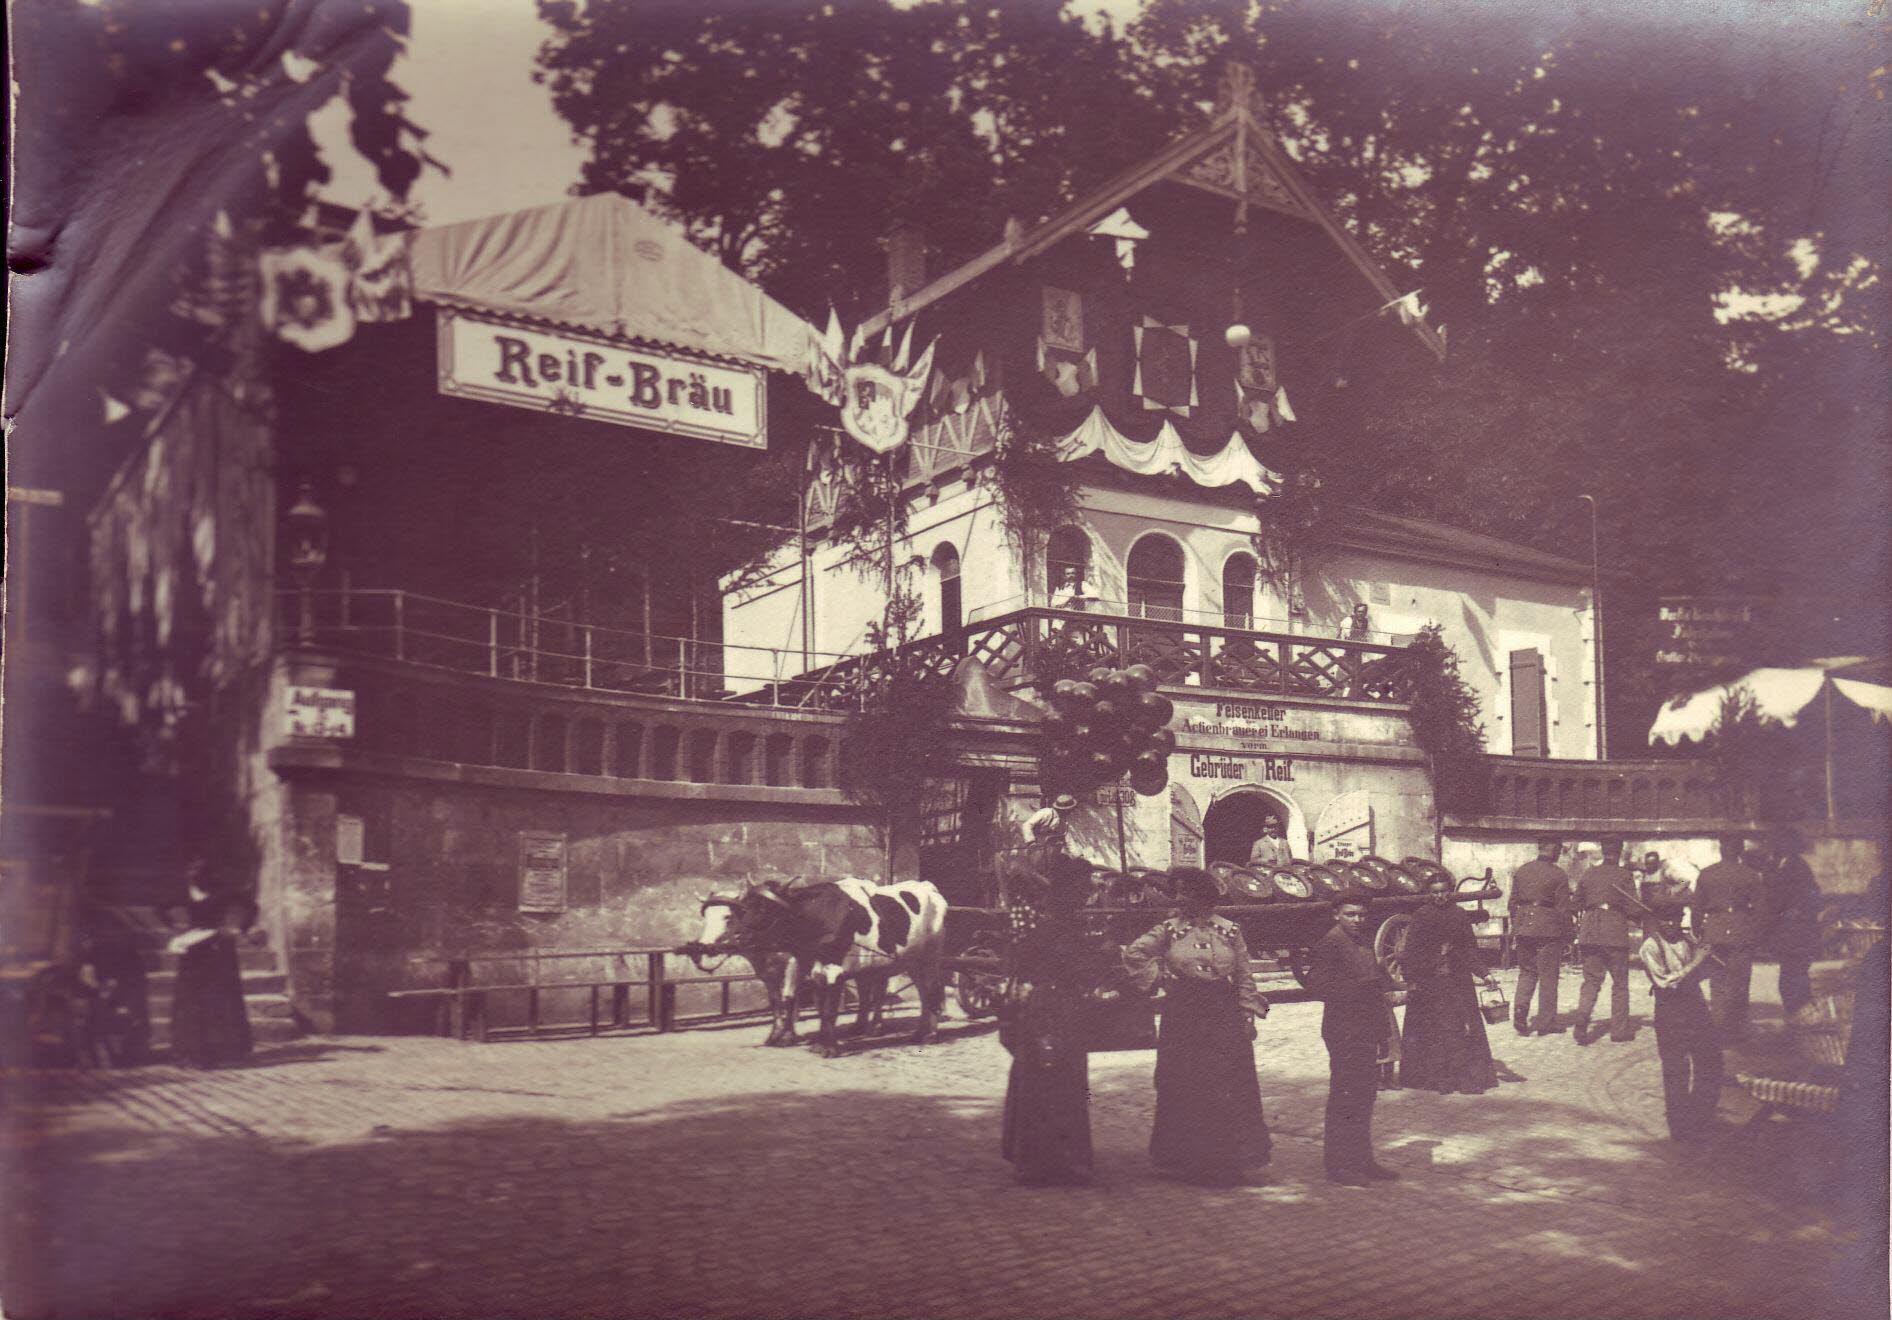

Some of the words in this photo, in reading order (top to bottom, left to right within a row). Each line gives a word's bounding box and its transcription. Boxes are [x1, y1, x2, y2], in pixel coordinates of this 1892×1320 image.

[494, 335, 734, 416] Reif-Bräu
[1270, 724, 1321, 741] Erlangen
[1190, 754, 1244, 779] Gebrüder
